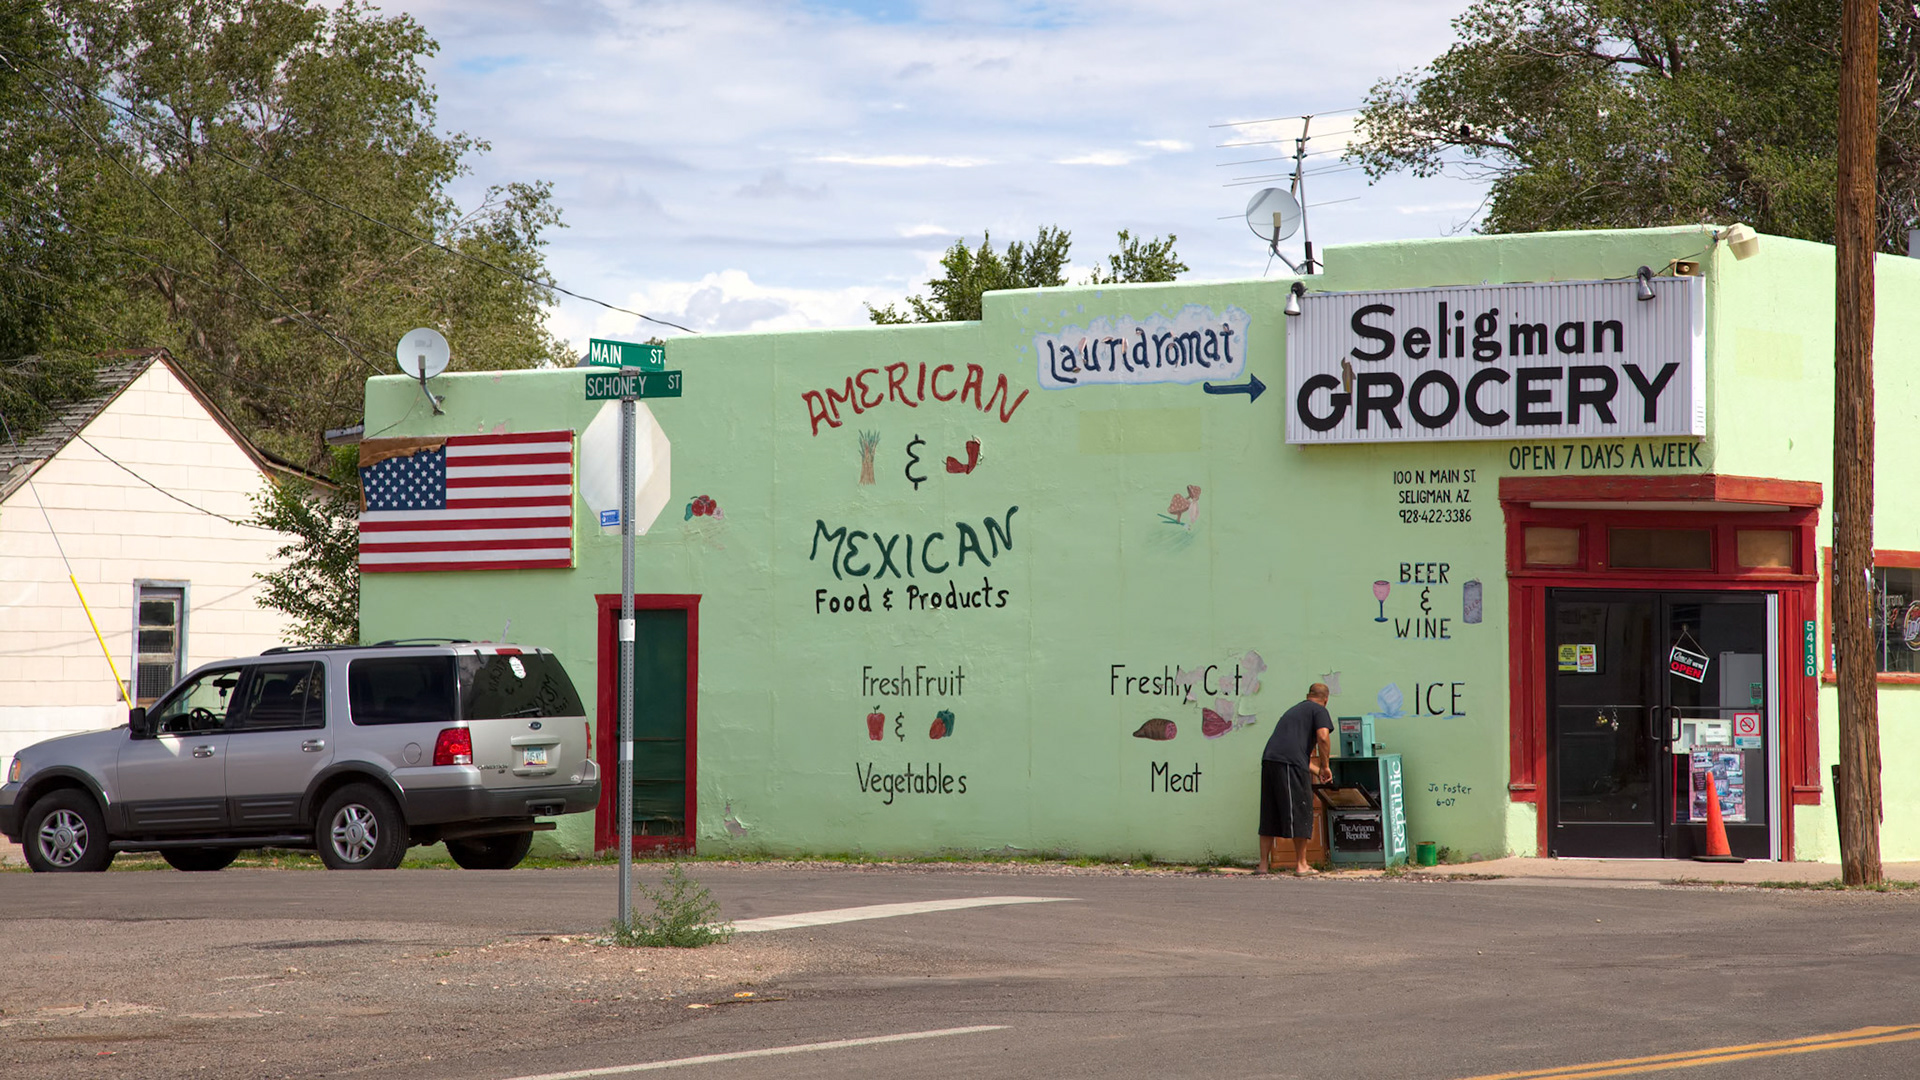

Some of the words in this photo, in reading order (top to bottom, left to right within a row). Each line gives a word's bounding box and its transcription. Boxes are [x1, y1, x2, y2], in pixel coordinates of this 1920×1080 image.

[1350, 302, 1623, 362] Seligman
[591, 343, 622, 365] MAIN
[650, 349, 663, 364] ST
[1047, 322, 1234, 384] Laundromat
[587, 376, 647, 397] SCHONEY
[668, 374, 680, 390] ST
[802, 362, 1030, 436] AMERICAN
[1297, 362, 1680, 432] GROCERY
[905, 434, 927, 490] &
[1509, 445, 1555, 470] OPEN
[1562, 445, 1572, 470] 7
[1580, 444, 1624, 469] DAYS
[1630, 444, 1646, 468] A
[1649, 442, 1702, 468] WEEK
[1394, 471, 1412, 484] 100
[1430, 470, 1460, 484] MAIN
[810, 506, 1019, 580] MEXICAN
[1400, 563, 1450, 584] BEER
[816, 584, 872, 614] Food
[882, 588, 893, 611] &
[906, 577, 1009, 610] Products
[1420, 586, 1432, 615] &
[1395, 618, 1451, 639] WINE
[1806, 621, 1814, 676] 54130
[1204, 664, 1242, 696] Ct
[1671, 661, 1702, 678] OPEN
[1416, 682, 1466, 716] ICE
[894, 712, 905, 742] &
[856, 762, 966, 806] Vegetables
[1150, 762, 1202, 793] Meat
[1428, 783, 1439, 794] Jo
[1443, 783, 1472, 794] Foster
[1391, 760, 1406, 855] Republic
[1436, 798, 1456, 807] 6-07
[1340, 824, 1351, 832] The
[1352, 824, 1375, 832] Arizona
[1346, 832, 1371, 840] Republic
